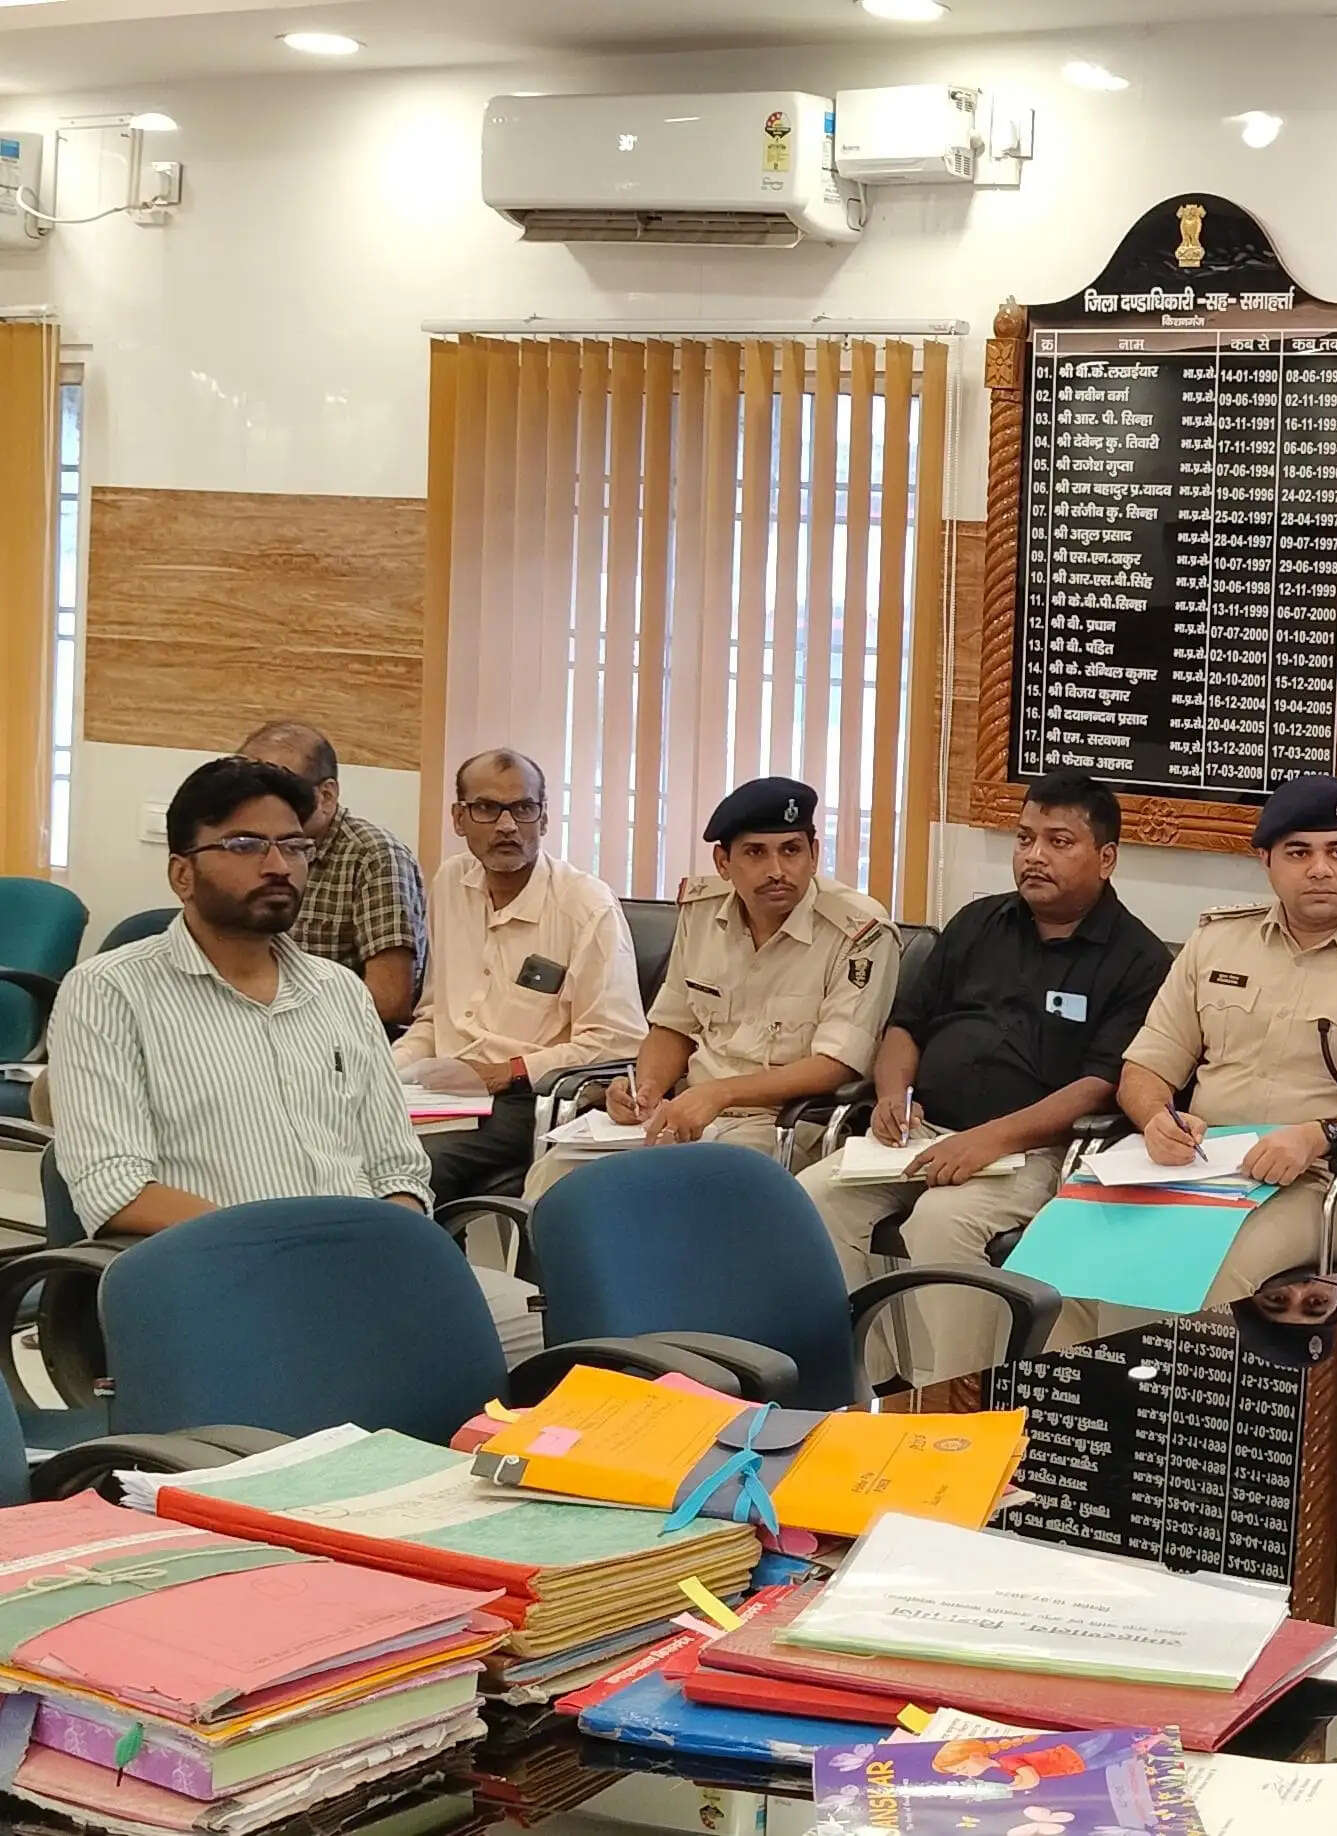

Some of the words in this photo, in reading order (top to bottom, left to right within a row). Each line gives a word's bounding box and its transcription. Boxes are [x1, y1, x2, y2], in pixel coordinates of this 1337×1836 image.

[1084, 289, 1117, 313] जिला
[1121, 287, 1194, 312] दण्डाधिकारी
[1119, 339, 1144, 350] नाम
[1231, 339, 1253, 350] कब
[1258, 335, 1270, 350] से
[1221, 370, 1277, 382] 14-01-1990
[1058, 386, 1072, 401] श्री
[1075, 387, 1105, 401] नवीन
[1108, 388, 1129, 402] वर्मा
[1219, 394, 1277, 406] 09-06-1990
[1219, 417, 1275, 430] 03-11-1991
[1057, 433, 1071, 447] श्री
[1125, 434, 1159, 449] तिवारी
[1218, 441, 1275, 454] 17-11-1992
[1056, 456, 1070, 470] श्री
[1072, 456, 1104, 471] राजेश
[1106, 460, 1133, 477] गुप्ता
[1217, 464, 1274, 477] 07-06-1994
[1217, 487, 1274, 500] 19-06-1996
[1215, 511, 1273, 525] 25-02-1997
[1053, 524, 1067, 539] श्री
[1070, 529, 1099, 545] अतुल
[1102, 529, 1132, 542] प्रसाद
[1214, 534, 1272, 548] 28-04-1997
[1214, 557, 1271, 571] 10-07-1997
[1279, 560, 1337, 574] 29-06-1998
[1213, 580, 1270, 594] 30-06-1998
[1278, 583, 1336, 597] 12-11-1999
[1212, 604, 1269, 617] 13-11-1999
[1277, 607, 1336, 621] 06-07-2000
[1051, 615, 1064, 629] श्री
[1211, 626, 1268, 641] 07-07-2000
[1276, 630, 1334, 644] 01-10-2001
[1210, 649, 1266, 664] 02-10-2001
[1276, 653, 1333, 667] 19-10-2001
[1209, 672, 1266, 687] 20-10-2001
[1275, 676, 1333, 692] 15-12-2004
[1049, 683, 1062, 697] श्री
[1065, 683, 1096, 699] विजय
[1099, 690, 1131, 705] कुमार
[1208, 695, 1265, 710] 16-12-2004
[1274, 699, 1332, 714] 19-04-2005
[1048, 705, 1062, 719] श्री
[1118, 713, 1148, 726] प्रसाद
[1207, 719, 1264, 733] 20-04-2005
[1273, 723, 1331, 737] 10-12-2006
[1207, 741, 1264, 756] 13-12-2006
[1272, 746, 1330, 761] 17-03-2008
[1206, 764, 1262, 779] 17-03-2008
